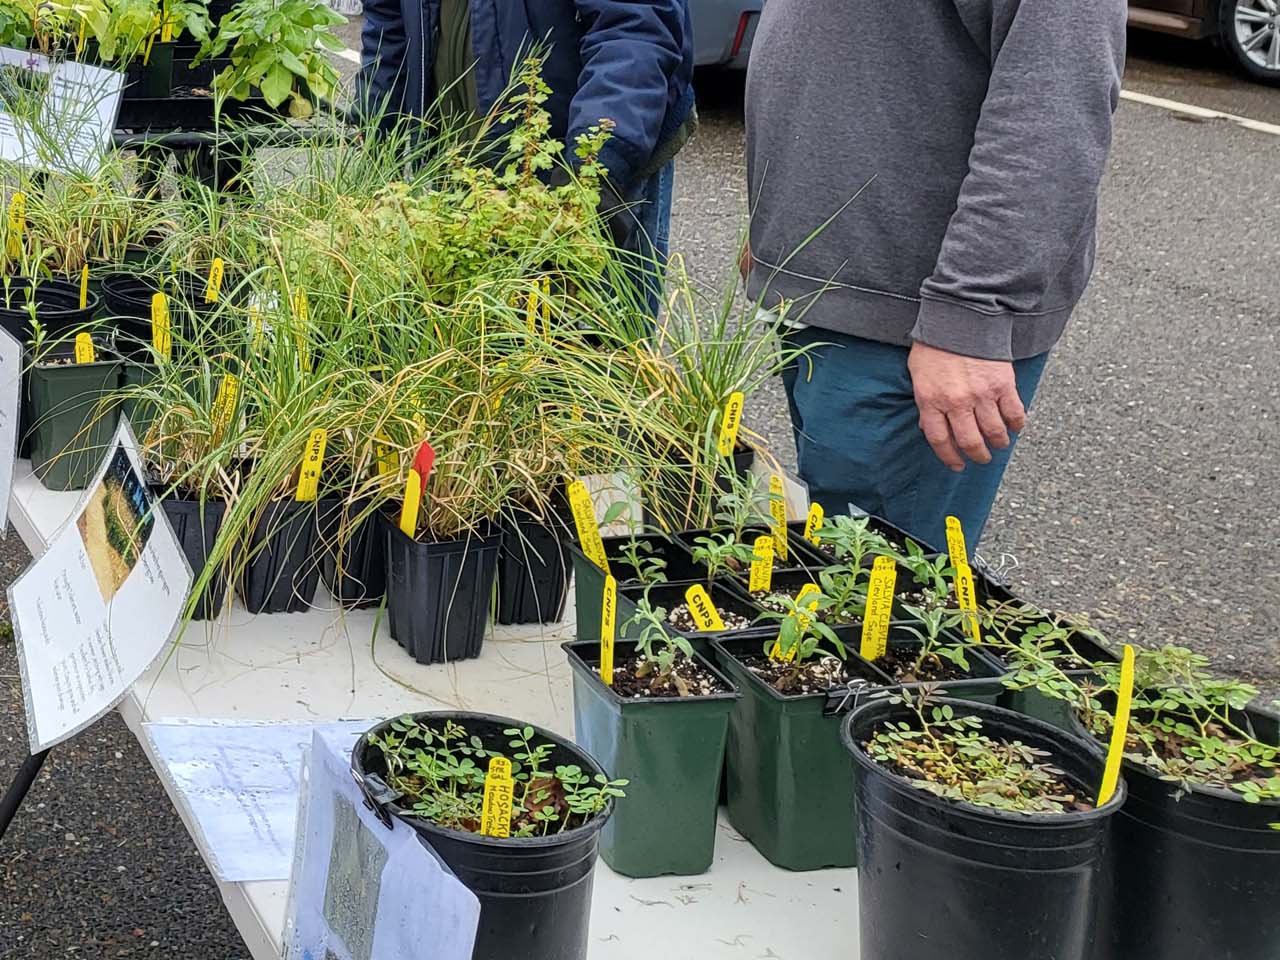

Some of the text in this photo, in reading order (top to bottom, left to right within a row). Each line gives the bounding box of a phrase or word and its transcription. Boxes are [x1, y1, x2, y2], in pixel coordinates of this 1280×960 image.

[726, 402, 739, 430] CNPS
[310, 432, 323, 462] CNPS
[881, 576, 894, 610] SALVIA
[692, 594, 714, 628] CNPS
